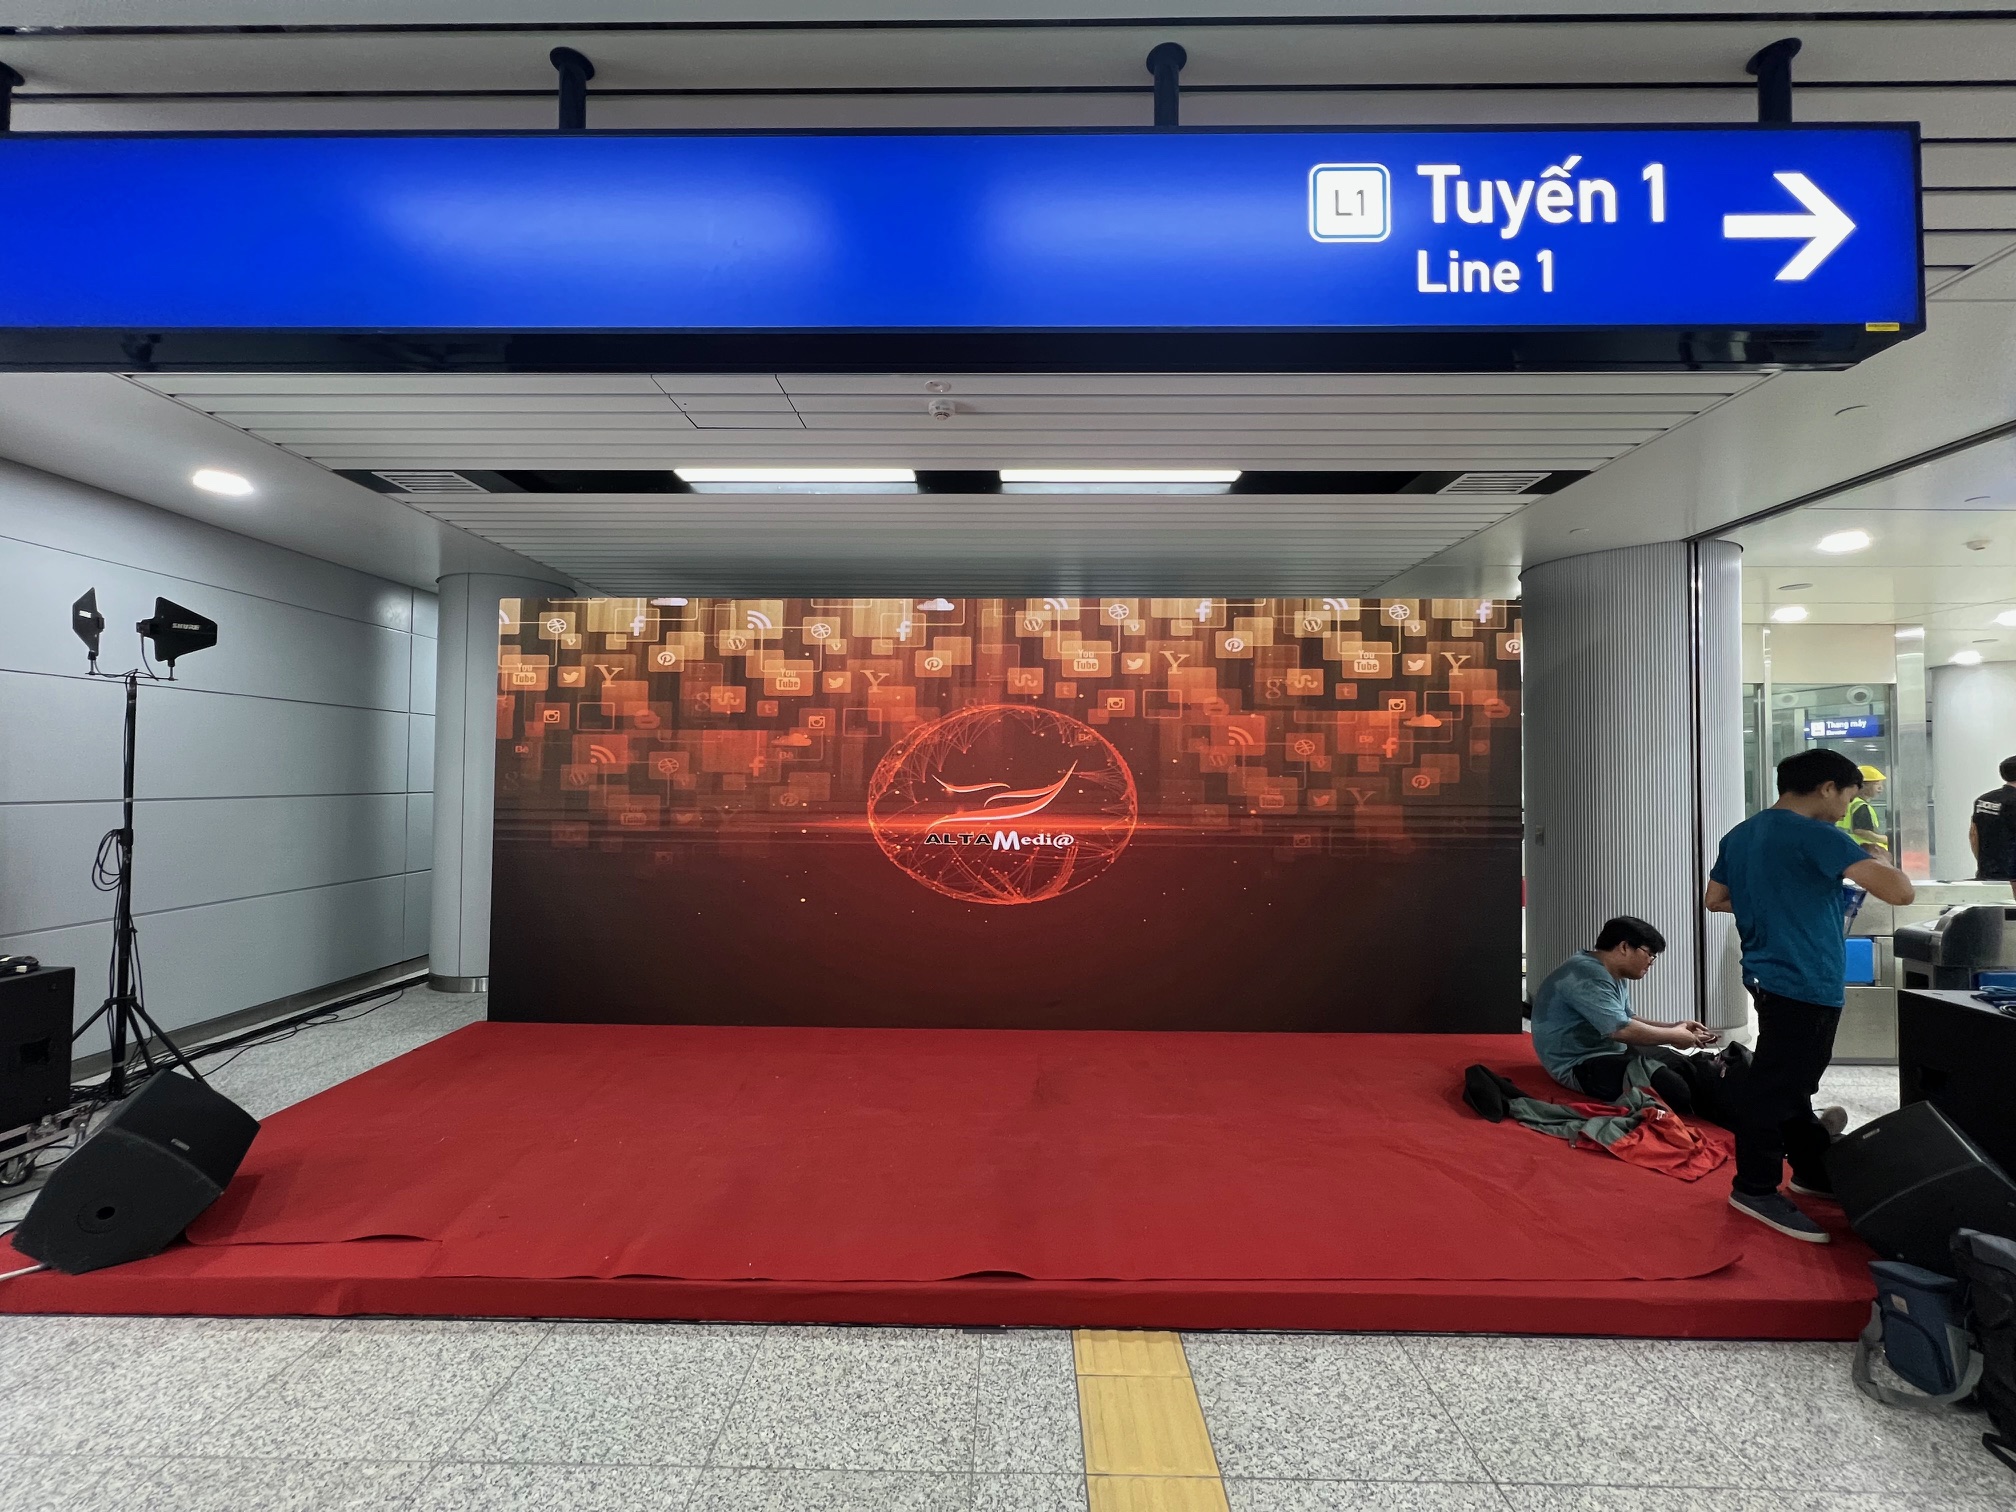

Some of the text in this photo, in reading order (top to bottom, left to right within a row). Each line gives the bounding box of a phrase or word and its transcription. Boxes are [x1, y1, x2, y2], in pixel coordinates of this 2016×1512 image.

[1416, 155, 1665, 239] Tuyến 1
[1334, 189, 1366, 217] L1
[1417, 249, 1554, 293] Line 1
[1077, 649, 1095, 659] You
[1358, 649, 1375, 659] You
[517, 662, 533, 672] You
[1075, 660, 1097, 670] Tube
[1356, 661, 1378, 671] Tube
[780, 667, 797, 677] You
[514, 673, 535, 684] Tube
[777, 679, 799, 689] Tube
